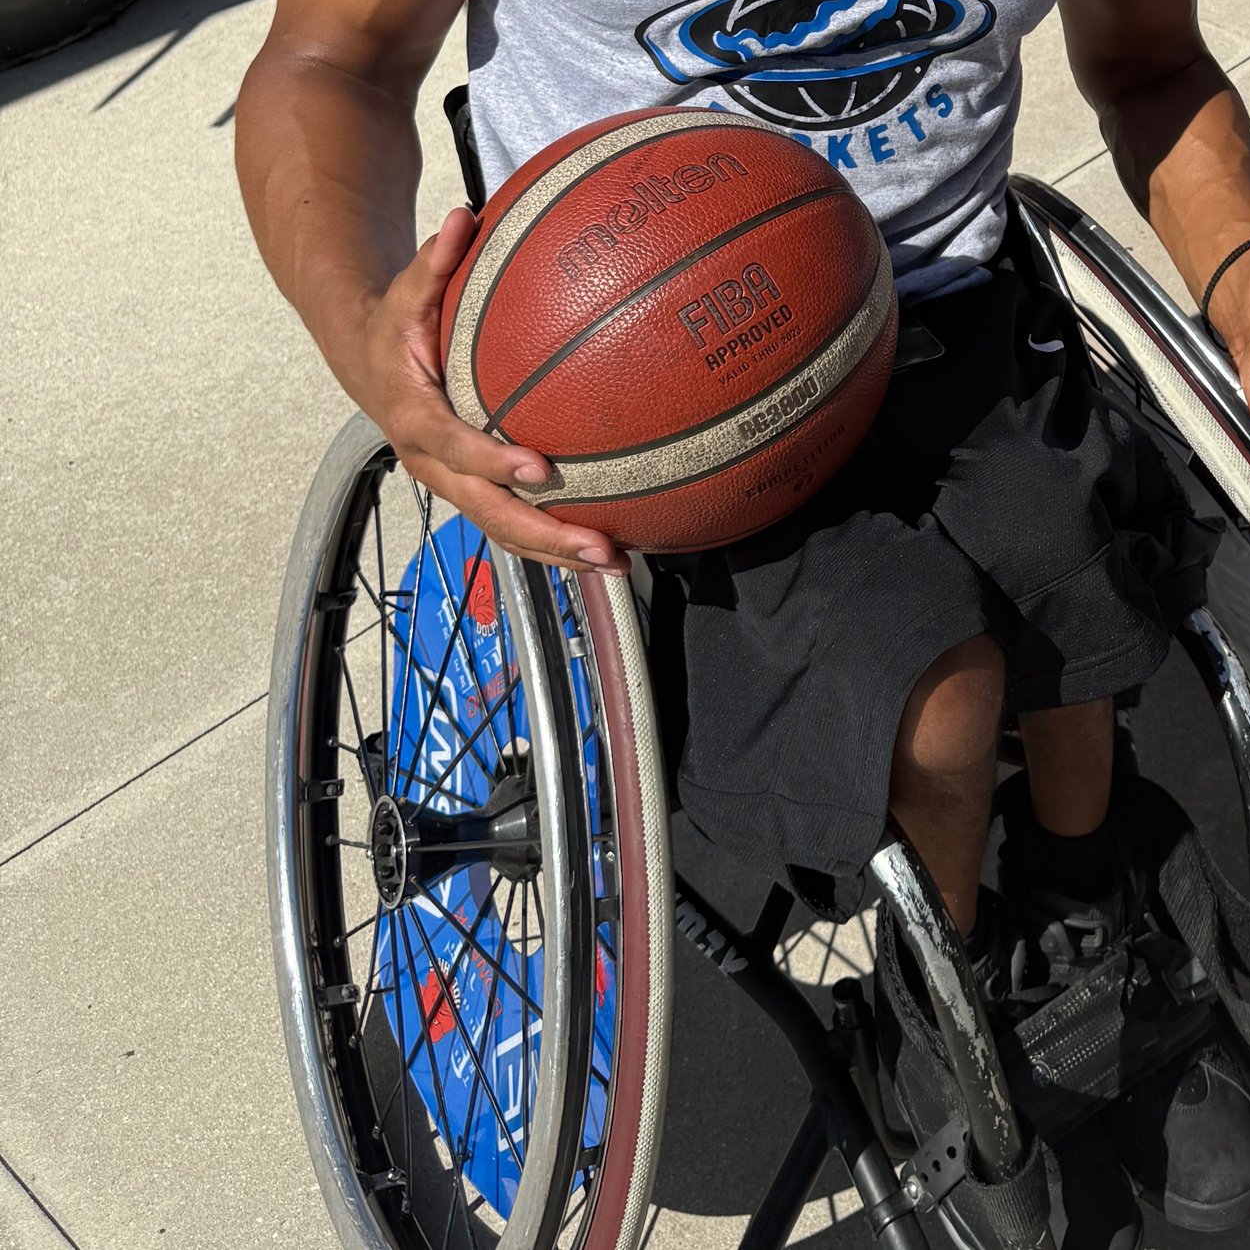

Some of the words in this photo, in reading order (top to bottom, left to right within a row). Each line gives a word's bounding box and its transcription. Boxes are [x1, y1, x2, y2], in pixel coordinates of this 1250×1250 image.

[709, 83, 954, 169] KETS
[556, 152, 749, 280] molten
[677, 262, 781, 350] FIBA
[705, 304, 794, 373] APPROVED
[718, 361, 750, 386] VALID
[752, 342, 779, 364] THRU
